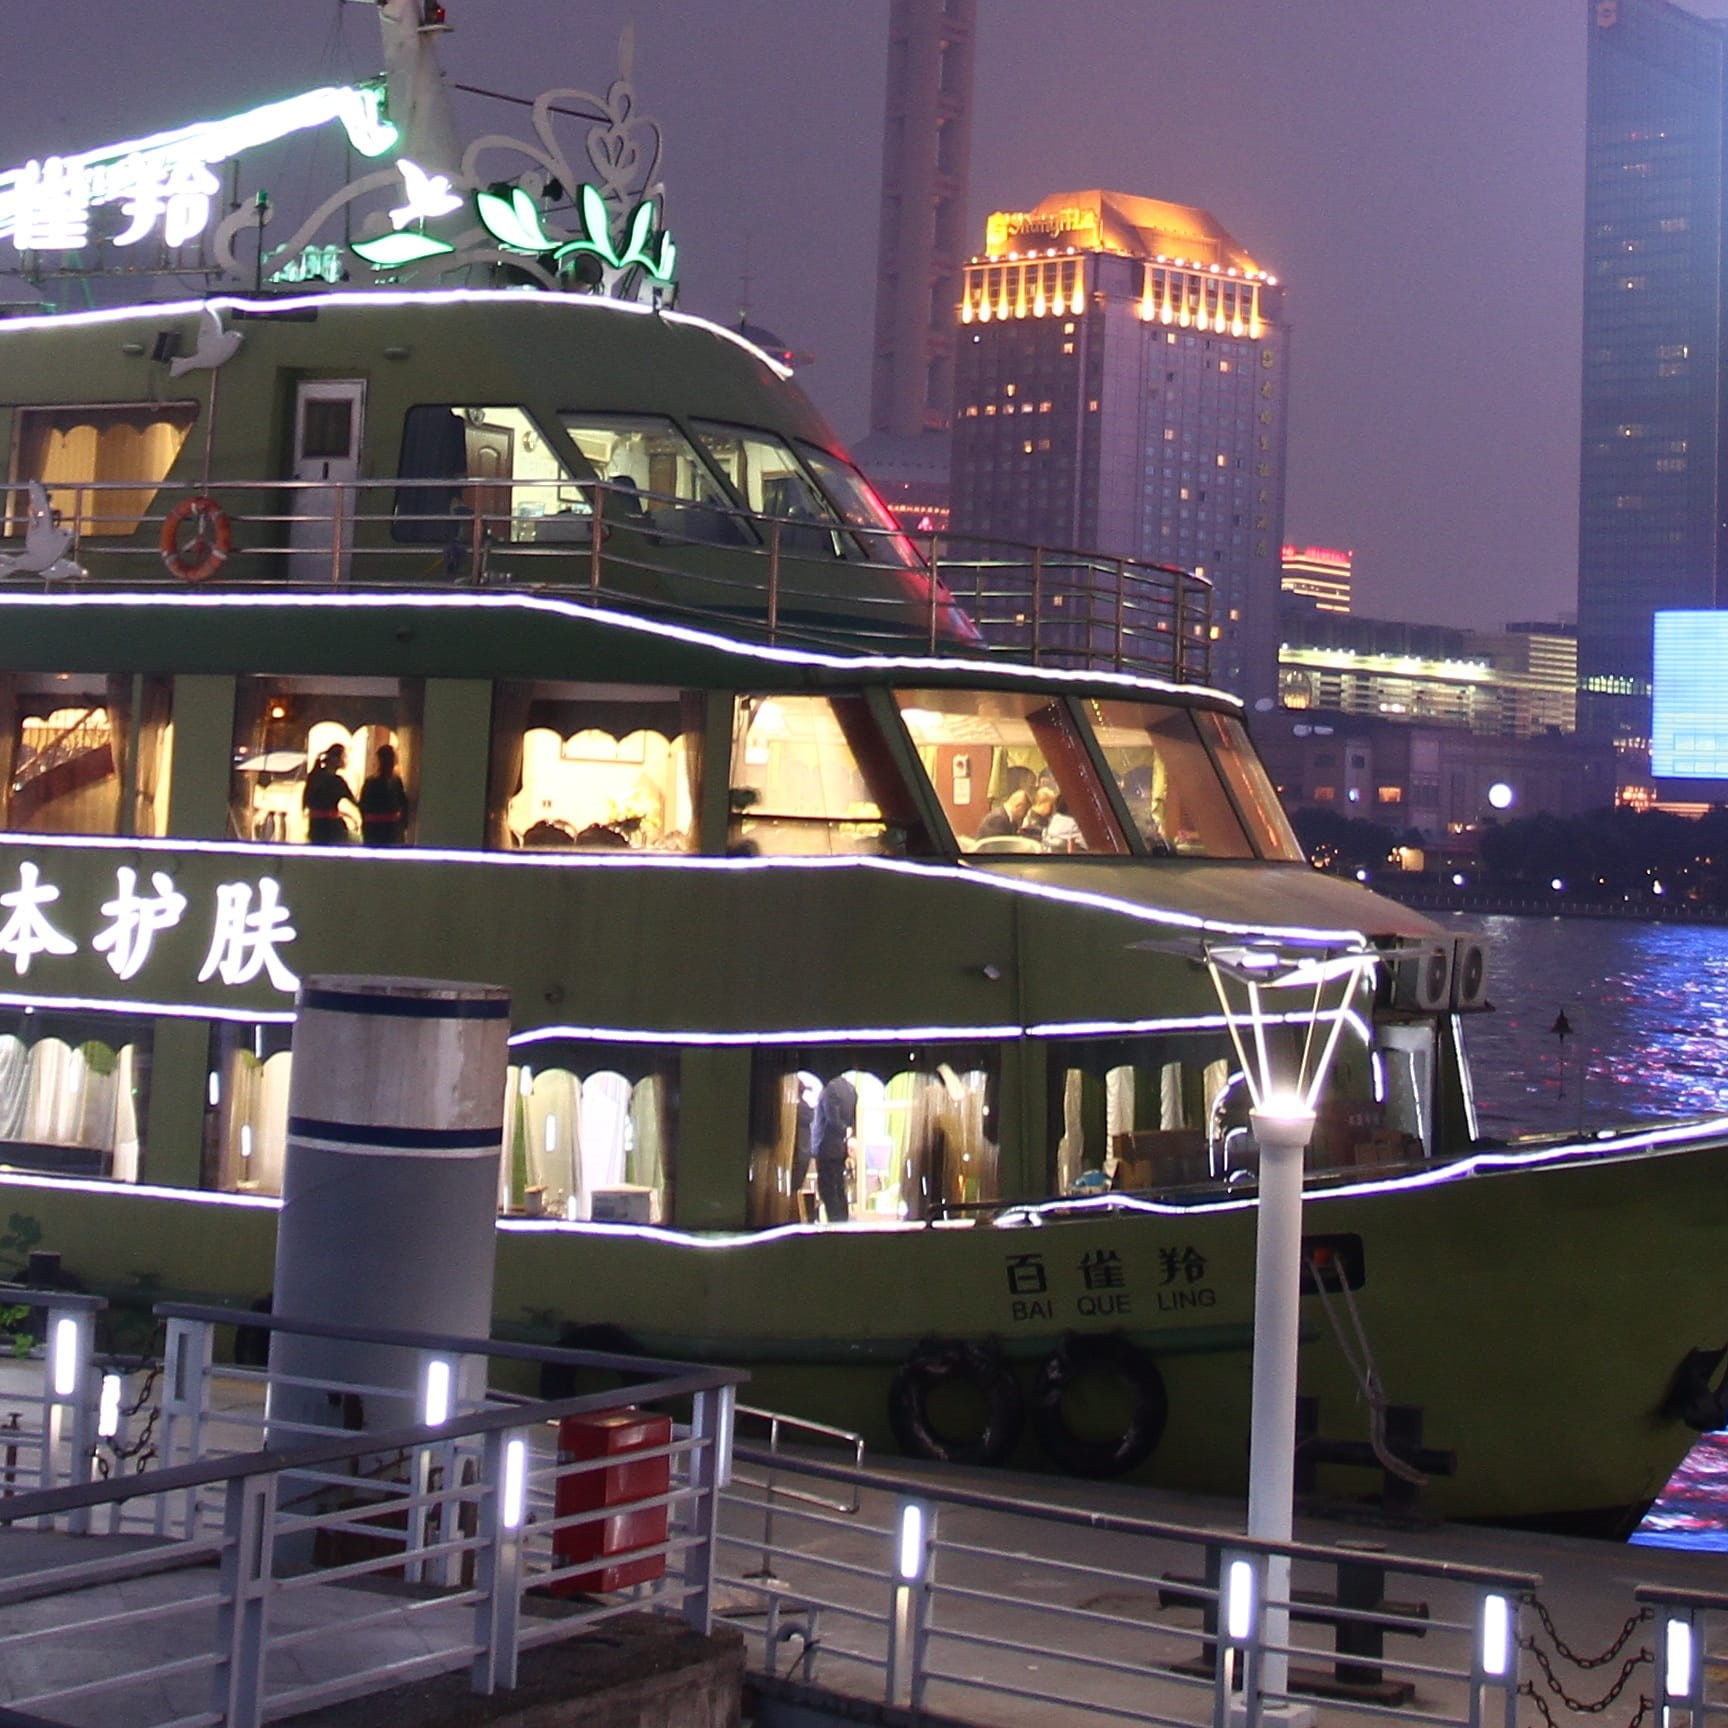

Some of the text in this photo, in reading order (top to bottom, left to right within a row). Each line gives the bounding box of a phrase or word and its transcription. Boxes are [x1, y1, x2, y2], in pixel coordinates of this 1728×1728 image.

[1005, 1246, 1208, 1295] 百雀羚
[1012, 1288, 1216, 1321] BAI QUE LING
